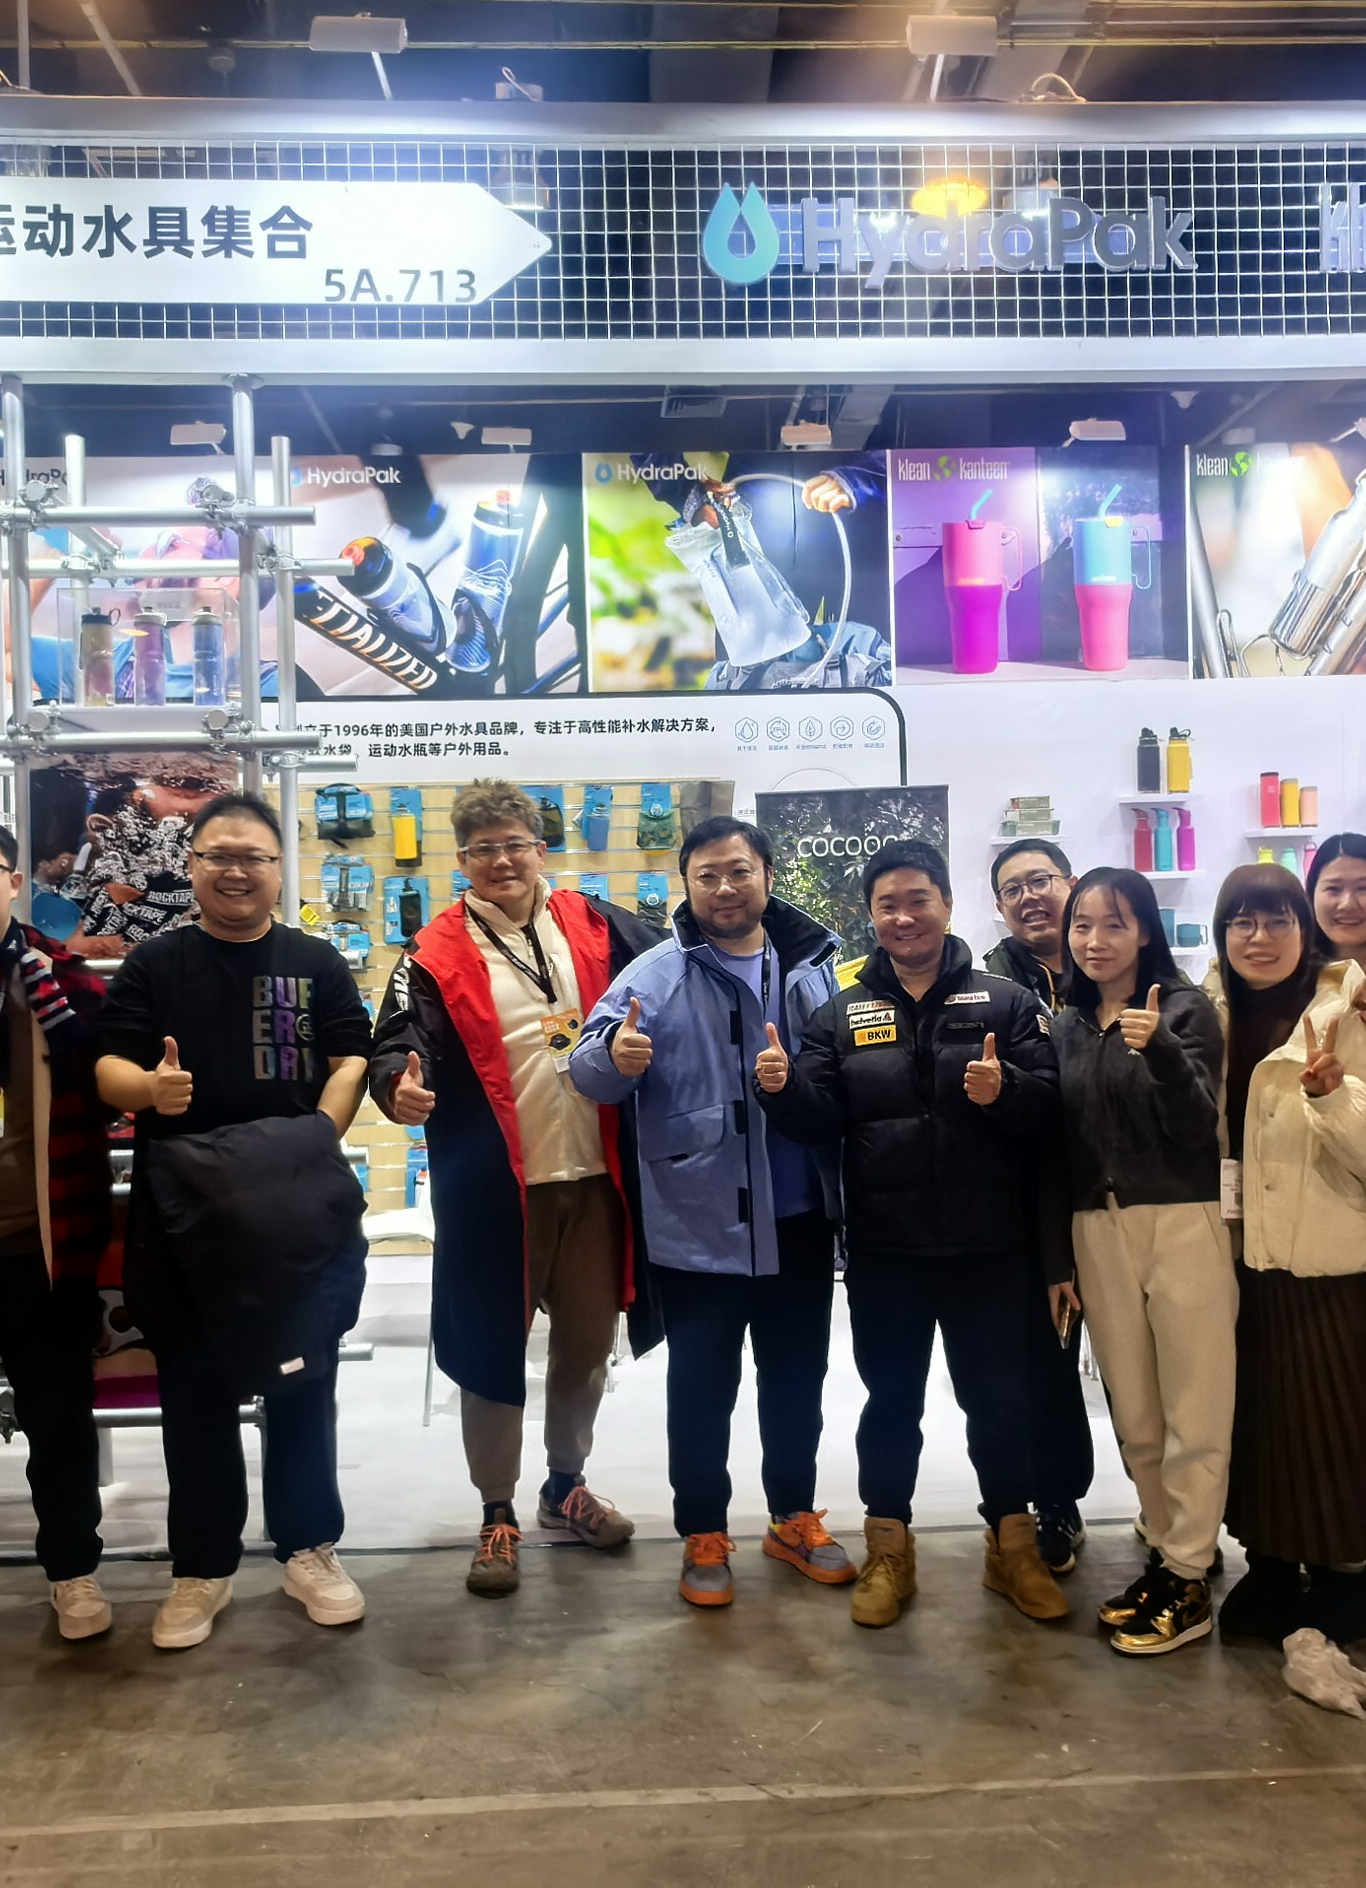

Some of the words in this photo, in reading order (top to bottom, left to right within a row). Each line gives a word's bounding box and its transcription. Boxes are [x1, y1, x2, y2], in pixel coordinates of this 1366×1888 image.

[801, 194, 1198, 289] HydraPak
[324, 269, 478, 303] 5A.713
[617, 463, 710, 484] HydraPak
[898, 458, 931, 481] klean
[959, 458, 1008, 480] kanteen
[1195, 453, 1229, 476] klean
[307, 466, 402, 487] HydraPak
[146, 890, 194, 904] ROCKTAP
[867, 1029, 891, 1041] BKW
